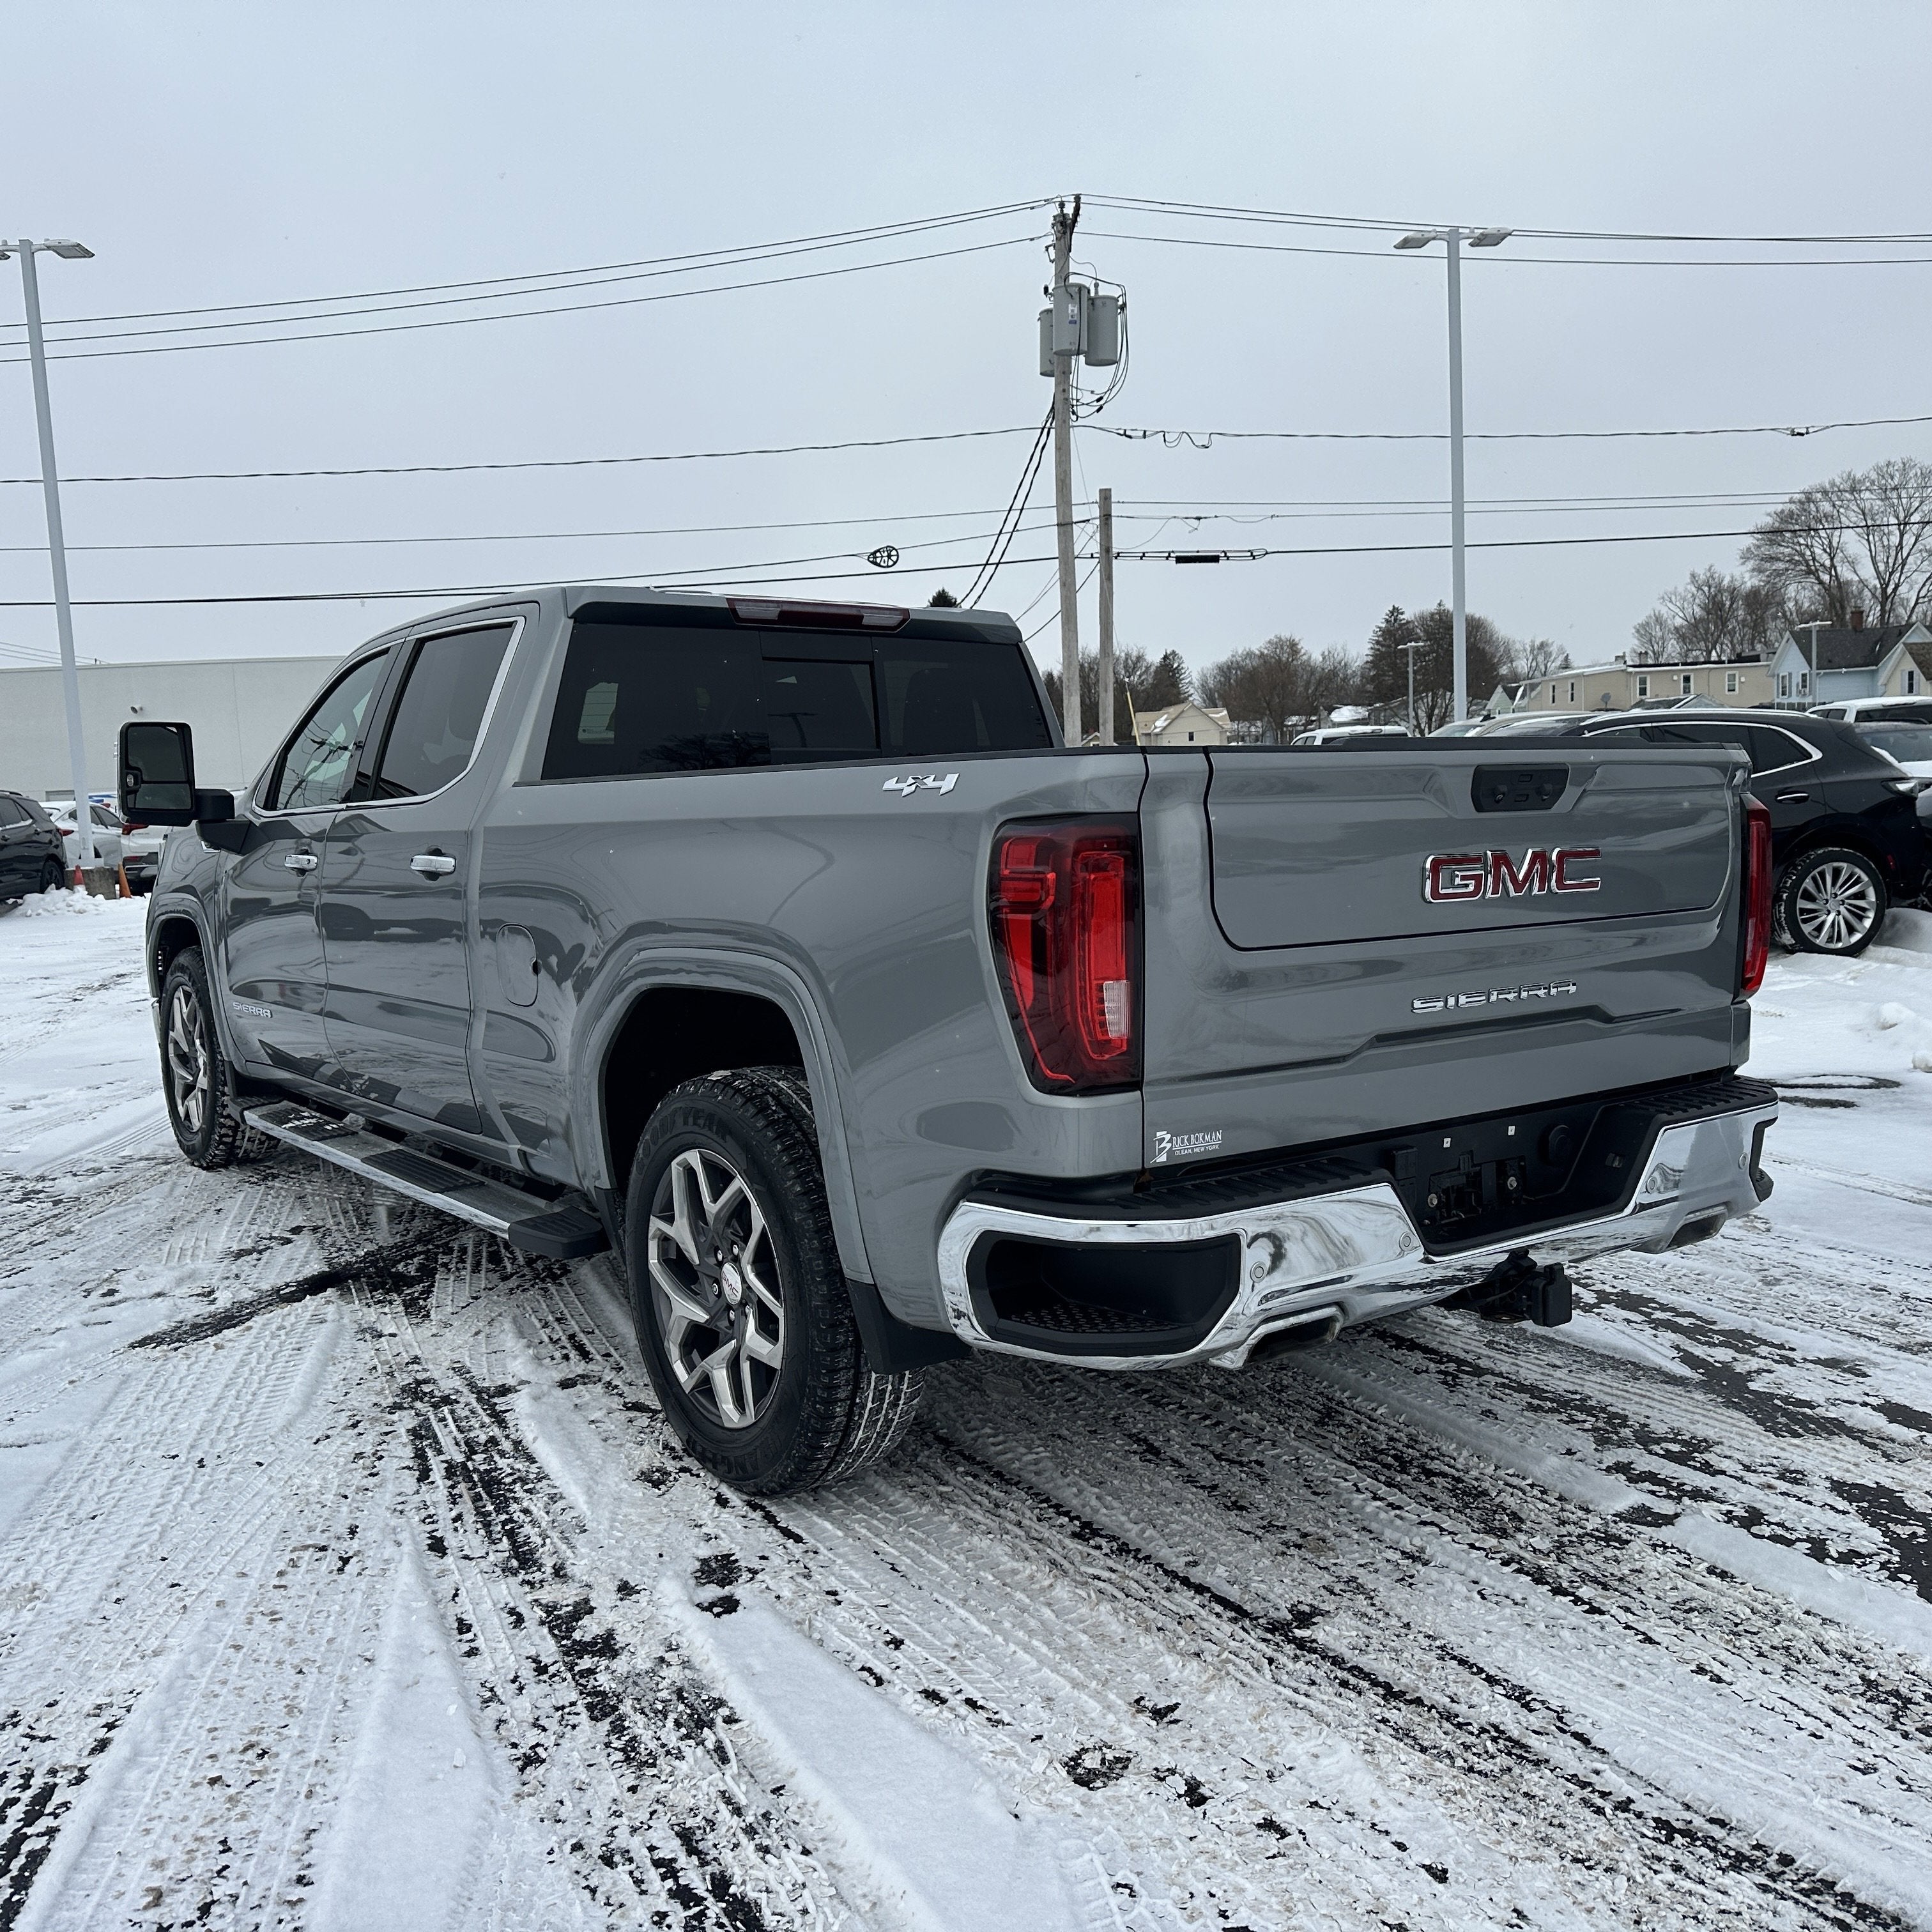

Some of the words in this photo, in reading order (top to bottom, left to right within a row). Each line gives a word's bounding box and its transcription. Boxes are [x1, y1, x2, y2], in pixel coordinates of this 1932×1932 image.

[1424, 847, 1602, 903] GMC
[233, 1001, 272, 1018] SIERRA
[1411, 979, 1577, 1013] SIERRA
[1190, 1130, 1222, 1145] BOKMAN
[721, 1270, 739, 1298] GMC
